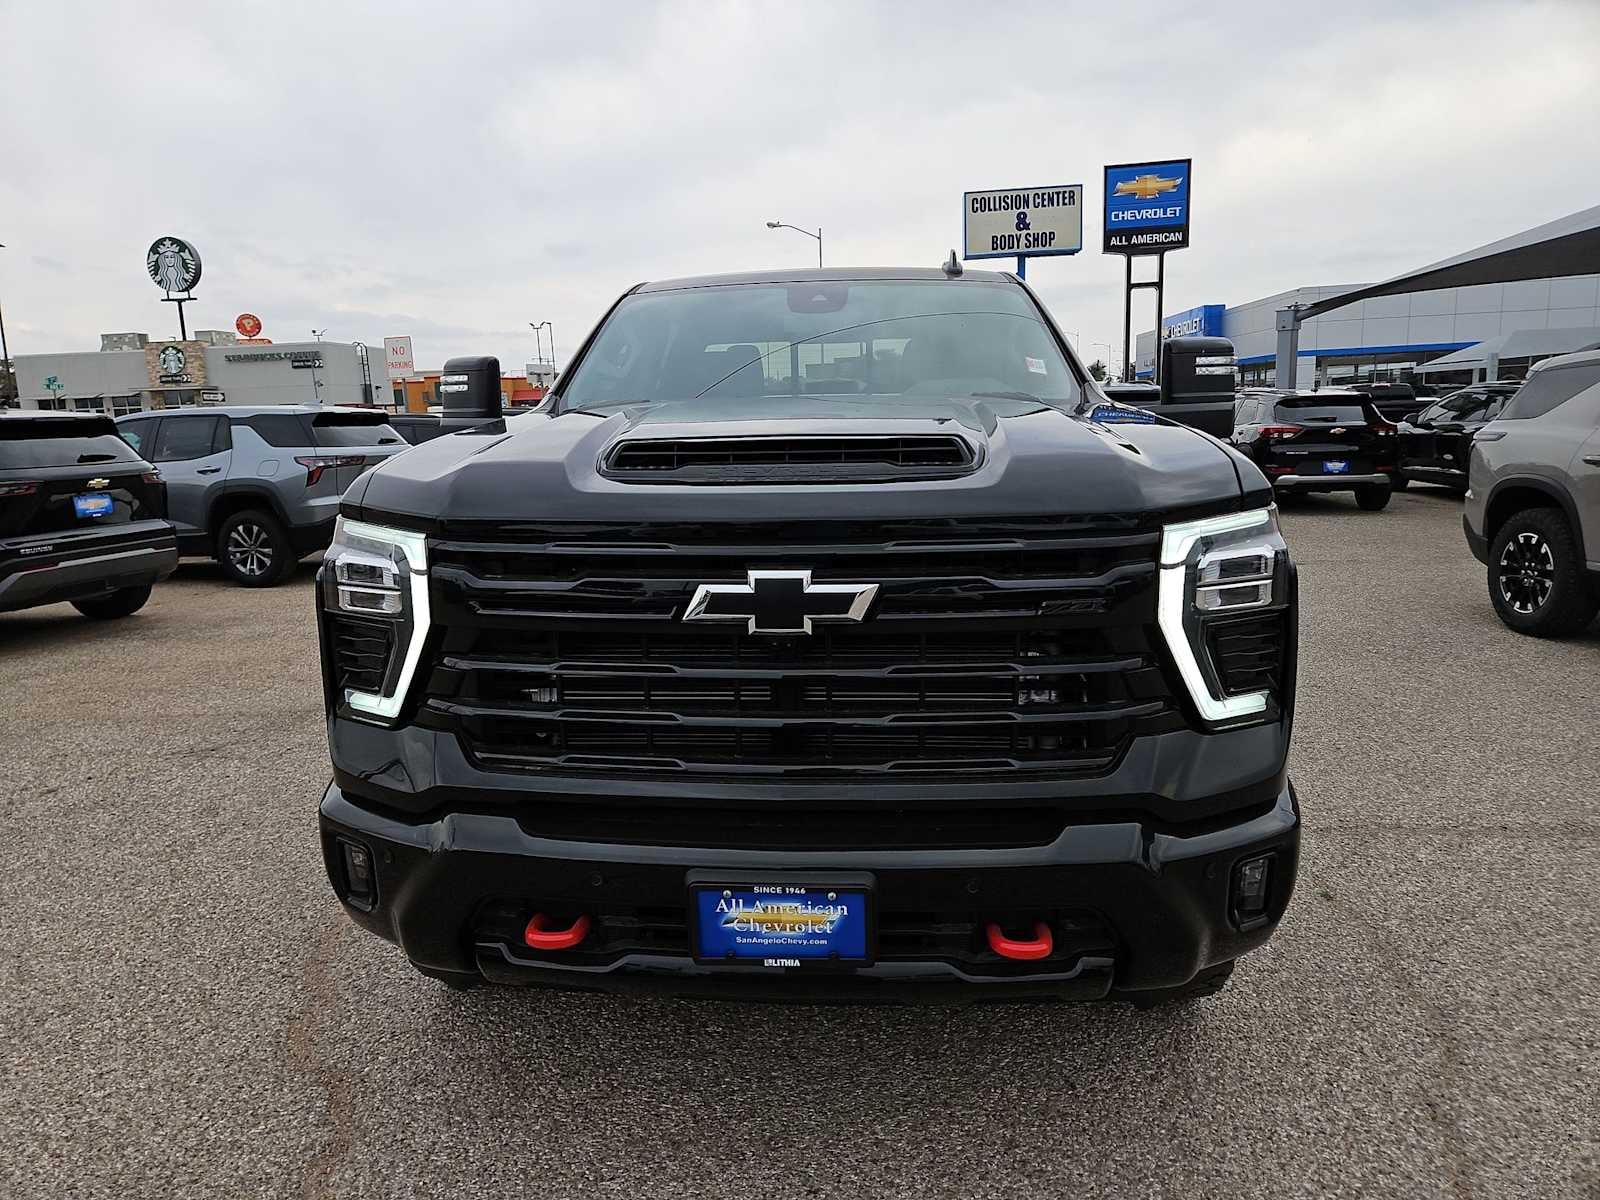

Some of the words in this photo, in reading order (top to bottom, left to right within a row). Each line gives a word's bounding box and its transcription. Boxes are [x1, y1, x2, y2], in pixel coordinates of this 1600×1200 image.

[971, 194, 1030, 214] COLLISION
[1033, 190, 1076, 209] CENTER
[1111, 207, 1182, 221] CHEVROLET
[1015, 211, 1031, 232] &
[991, 234, 1021, 251] BODY
[1025, 231, 1056, 248] SHOP
[1110, 235, 1128, 246] ALL
[1131, 231, 1183, 244] AMERICAN
[392, 346, 405, 356] NO
[387, 361, 413, 369] PARKING
[753, 886, 783, 894] SINCE
[785, 887, 806, 895] 1946
[715, 898, 744, 913] All
[752, 899, 849, 916] American
[733, 917, 833, 935] Chevrolet
[735, 936, 828, 946] SanAngeloChevy.com
[772, 958, 801, 967] LITHIA
